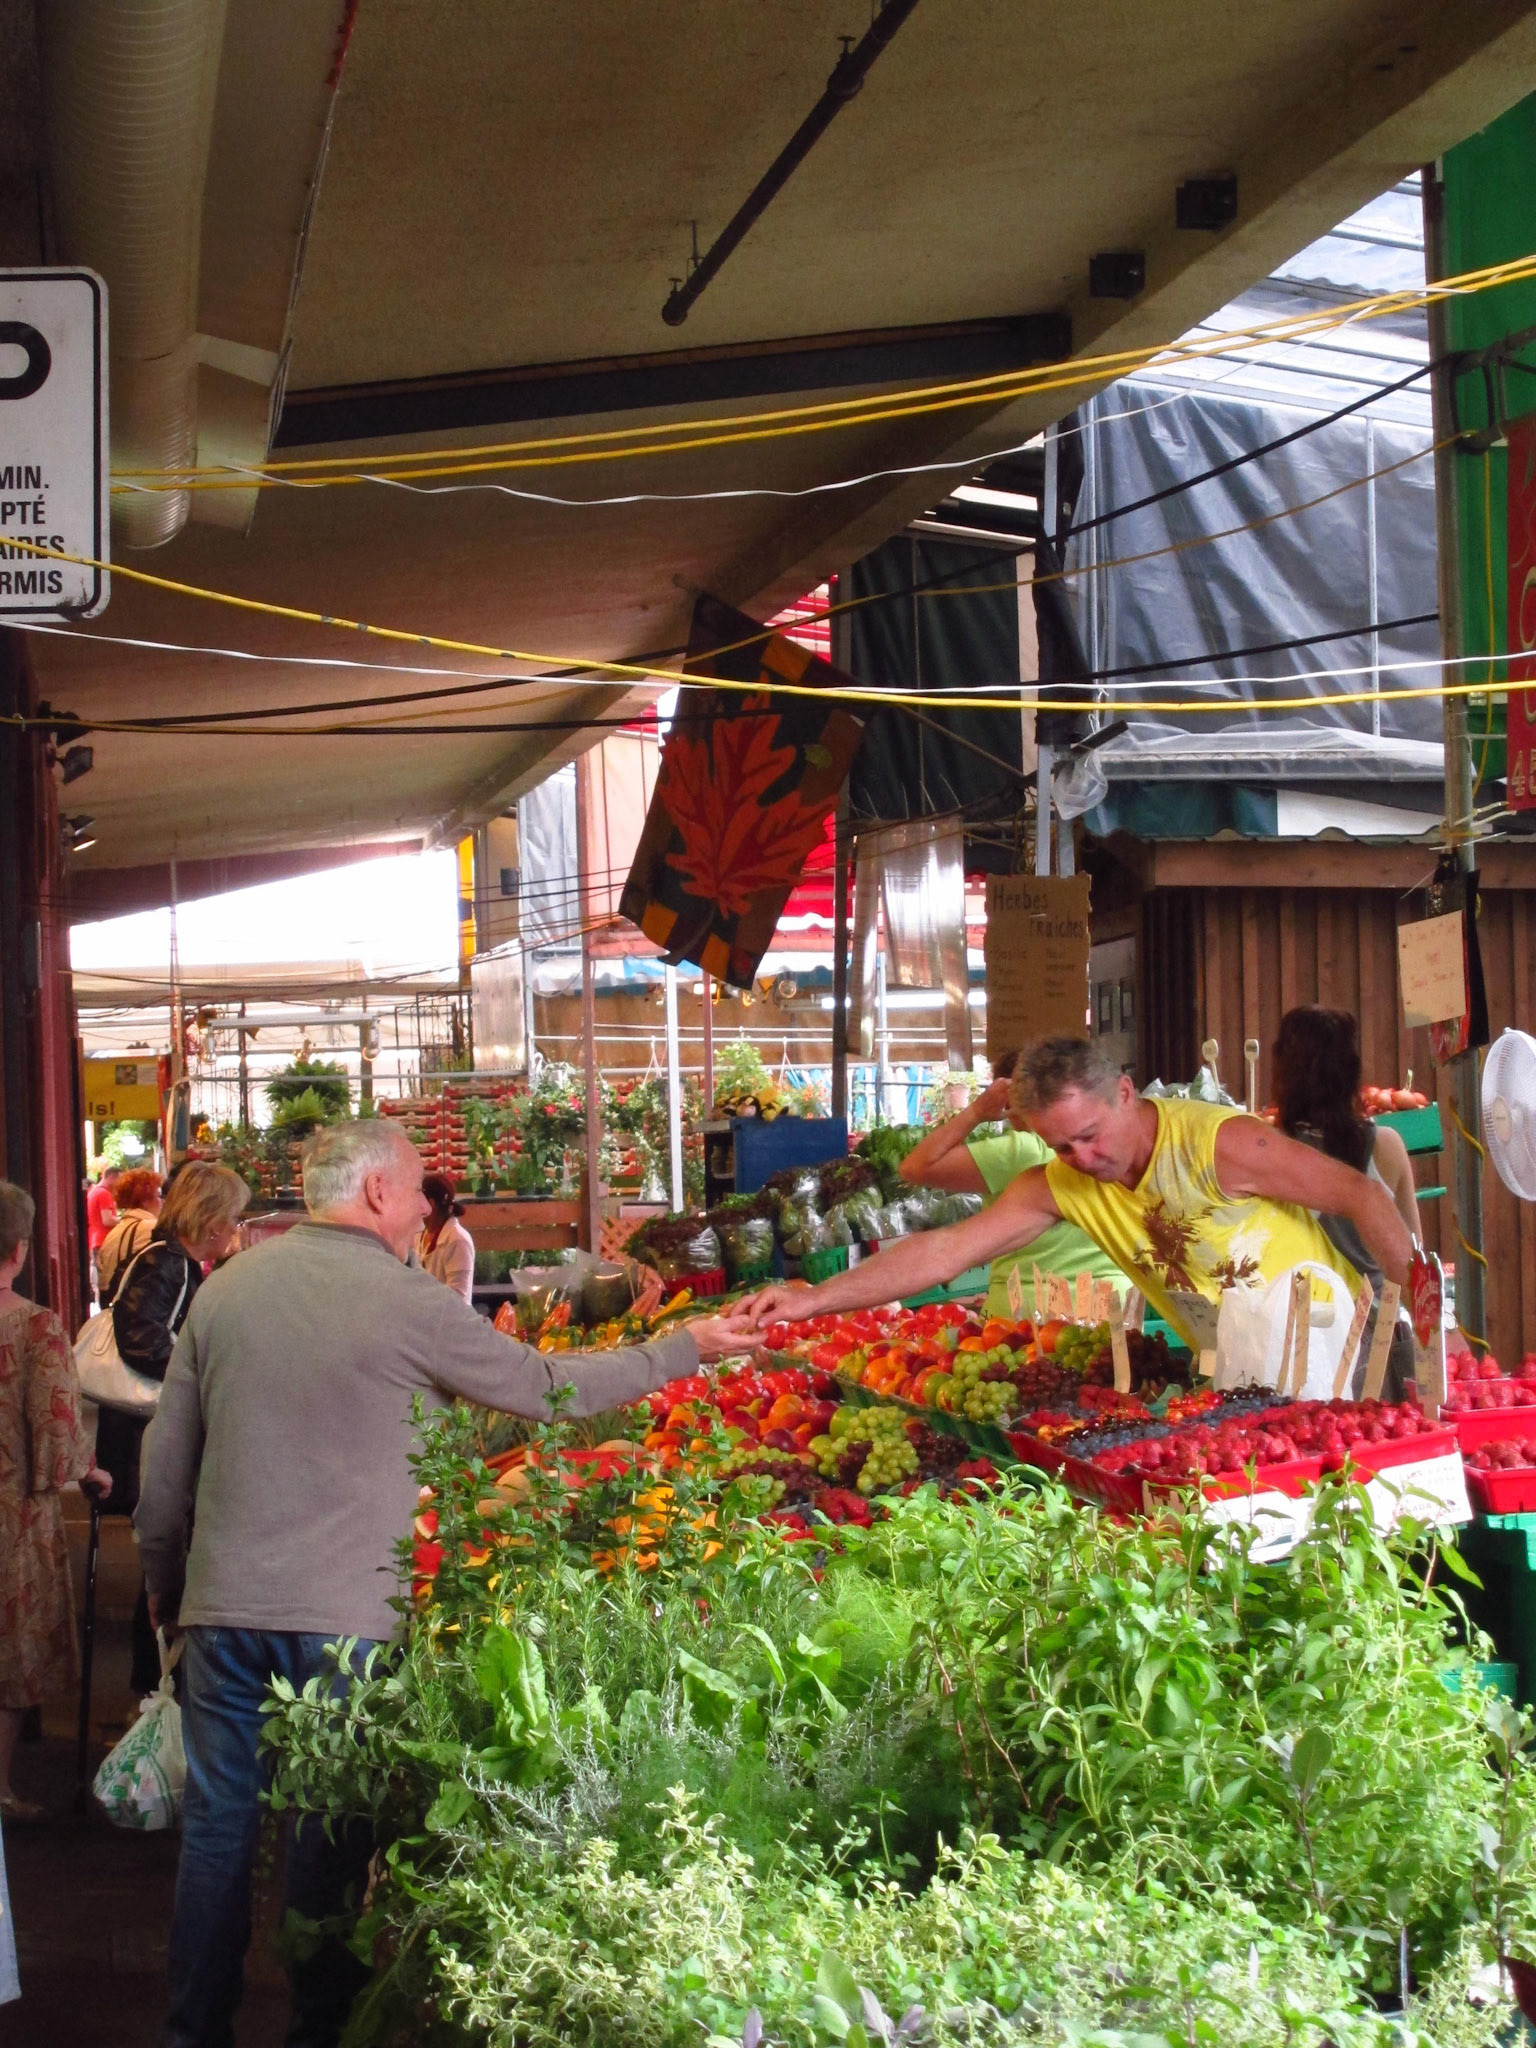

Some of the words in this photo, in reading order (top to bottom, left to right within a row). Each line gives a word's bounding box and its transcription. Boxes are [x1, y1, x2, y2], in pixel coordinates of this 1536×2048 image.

[0, 465, 50, 489] MIN.
[1, 494, 46, 525] PTÉ
[0, 570, 63, 595] RMIS
